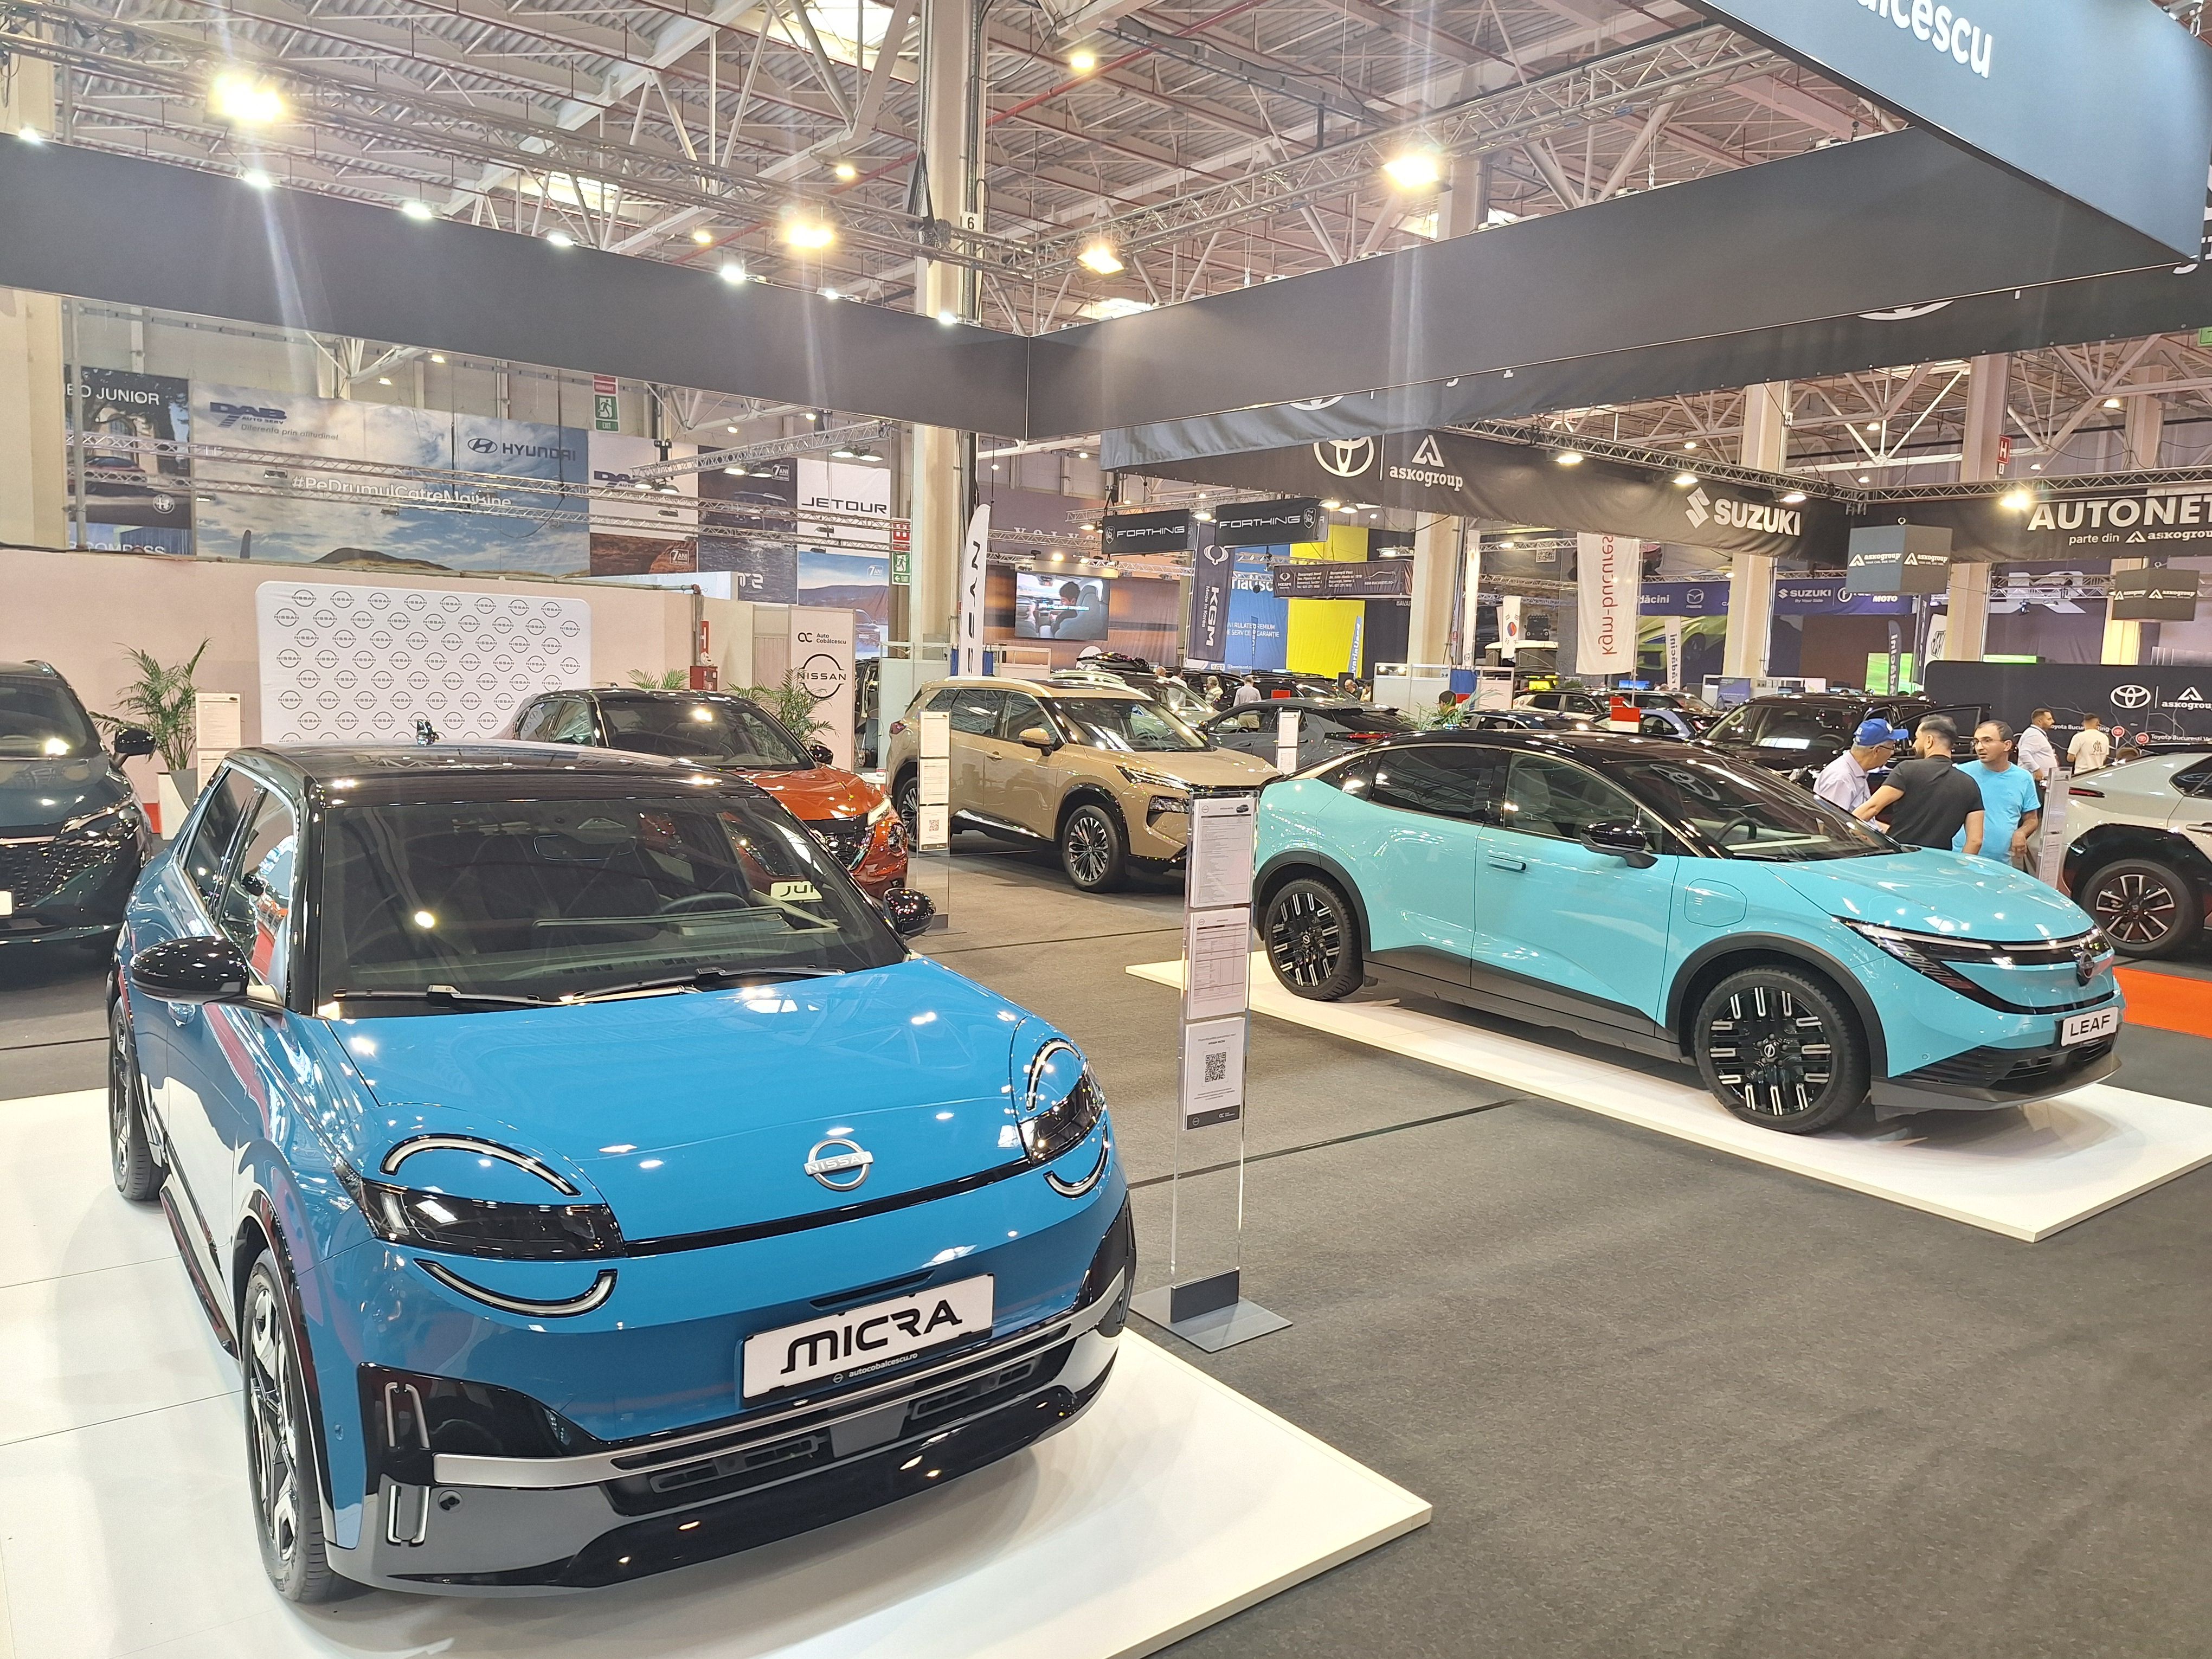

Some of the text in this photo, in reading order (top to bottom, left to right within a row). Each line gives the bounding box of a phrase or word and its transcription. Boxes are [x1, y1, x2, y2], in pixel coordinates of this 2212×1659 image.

[1856, 0, 1992, 79] cescu
[967, 217, 974, 230] 6
[97, 387, 160, 406] JUNIOR
[210, 401, 287, 420] DAB
[503, 443, 576, 461] HYUNDAI
[1999, 440, 2008, 459] H
[1389, 466, 1463, 492] askogroup
[801, 497, 888, 515] JETOUR
[1219, 515, 1301, 529] FORTHING
[1713, 498, 1801, 536] SUZUKI
[1116, 525, 1185, 538] FORTHING
[2068, 530, 2212, 546] parte din askogrou
[1917, 554, 1949, 563] askogroup
[1639, 594, 1670, 604] dăcini
[1790, 589, 1831, 597] SUZUKI
[1206, 587, 1220, 647] KGM
[798, 672, 846, 680] NISSAN
[2069, 1014, 2111, 1038] LEAF
[807, 1153, 870, 1174] NISSAN
[780, 1299, 963, 1375] MICRA
[848, 1353, 918, 1378] autocobalcescu.ro
